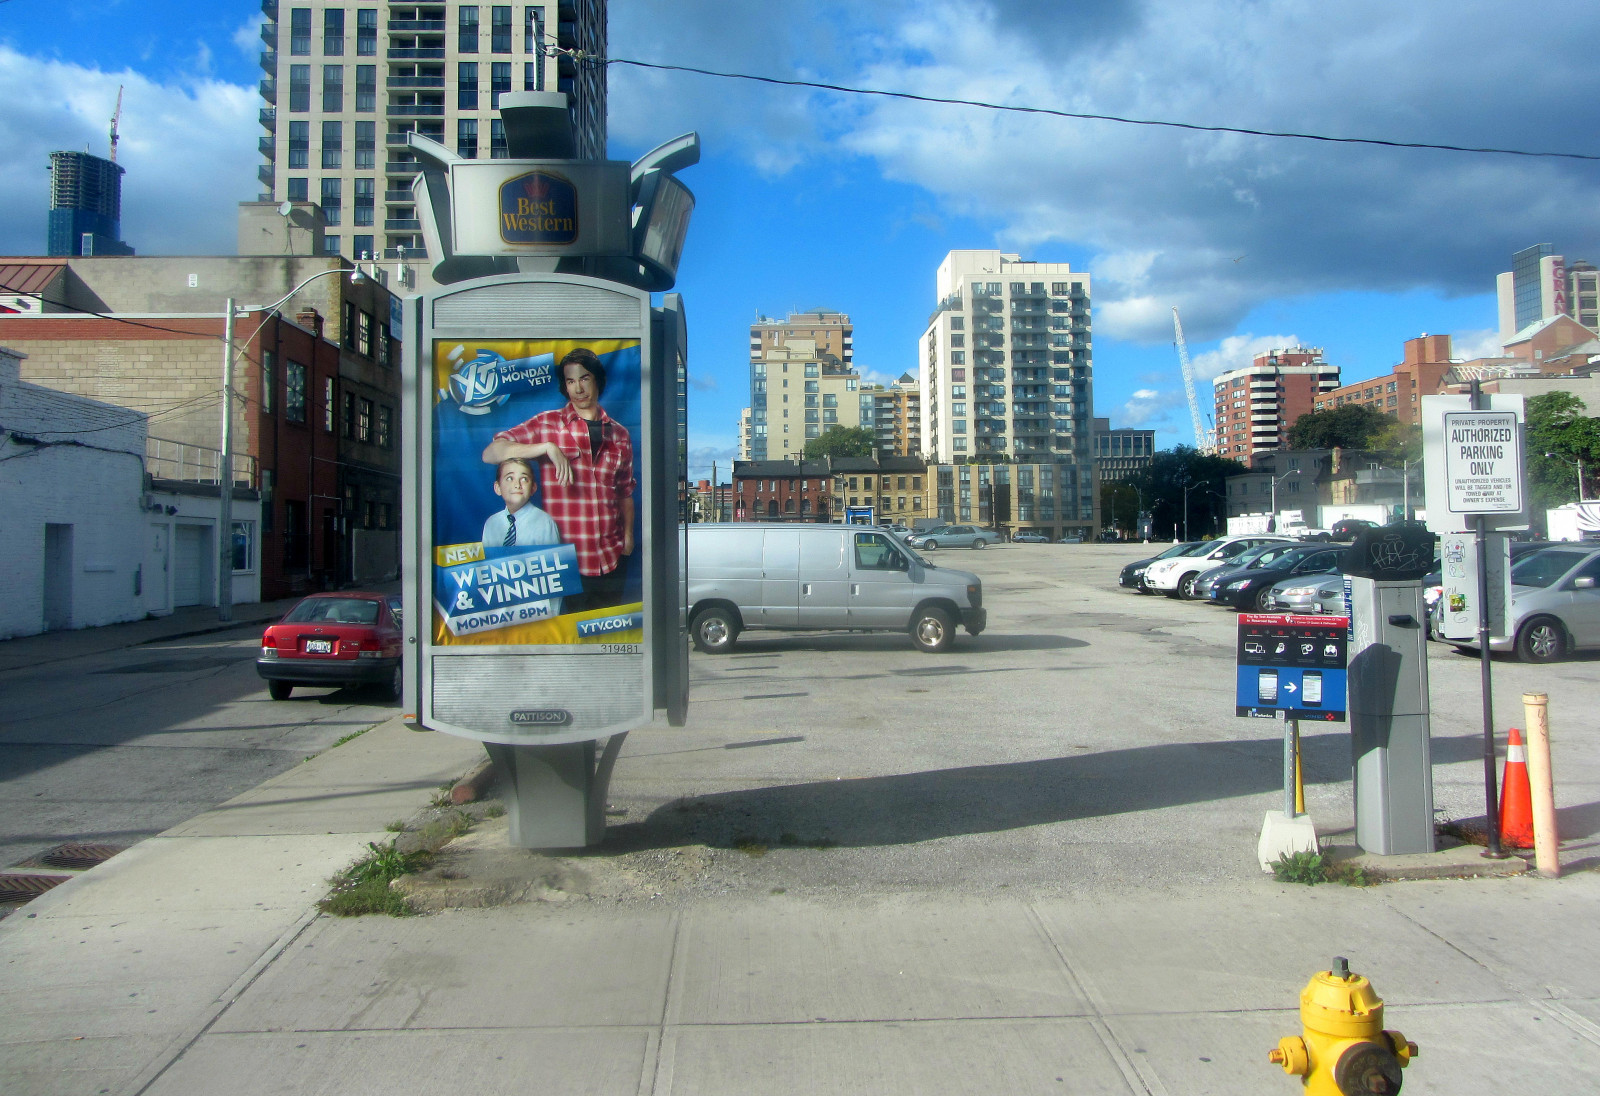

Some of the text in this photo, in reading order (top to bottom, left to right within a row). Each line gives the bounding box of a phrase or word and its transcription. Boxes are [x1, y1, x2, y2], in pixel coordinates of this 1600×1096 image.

[517, 197, 555, 215] Best
[503, 213, 573, 231] Western
[500, 364, 516, 374] IS IT
[501, 364, 550, 384] MONDAY
[528, 375, 552, 387] YET?
[1451, 428, 1511, 443] AUTHORIZED
[1460, 445, 1503, 460] PARKING
[1470, 461, 1494, 475] ONLY
[445, 546, 480, 564] NEW
[451, 552, 569, 589] WENDELL
[456, 573, 564, 610] & VINNIE
[456, 606, 548, 631] MONDAY 8PM
[581, 617, 633, 633] YTV.COM
[600, 644, 639, 653] 319481
[514, 712, 561, 721] PATTISON
